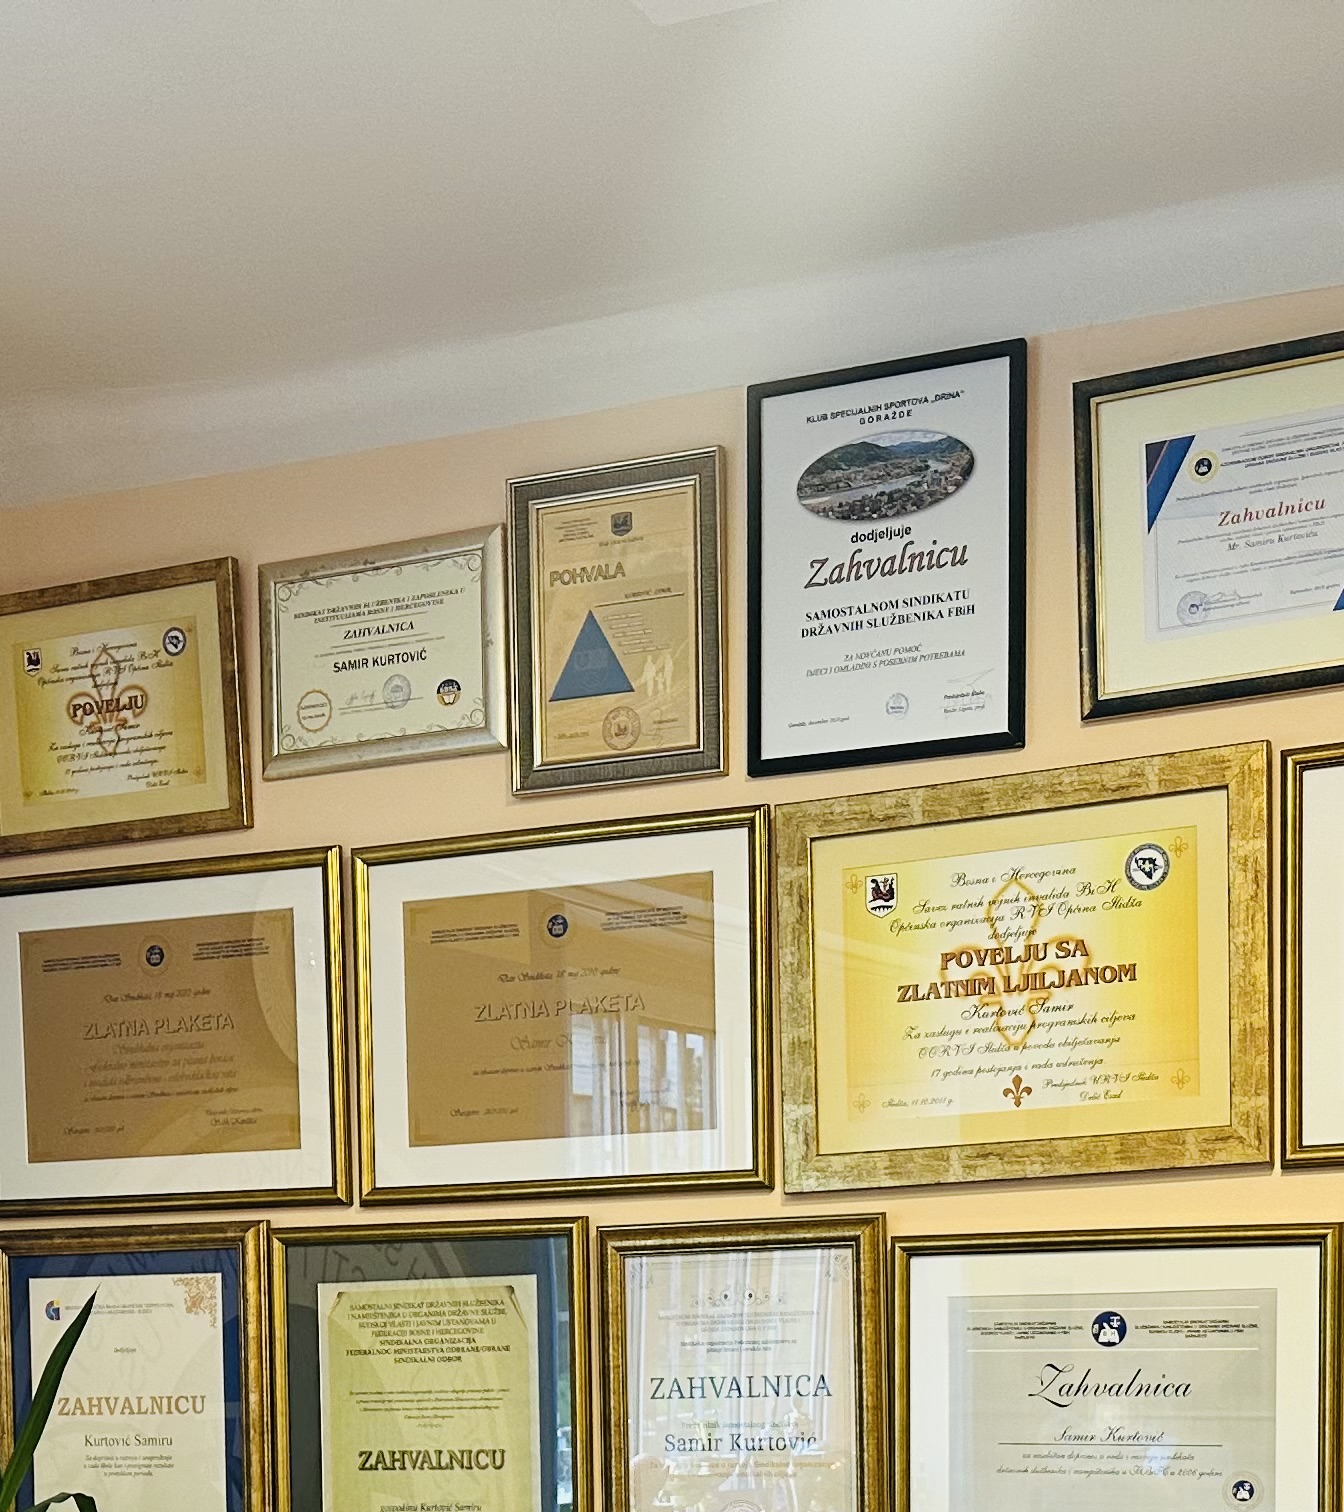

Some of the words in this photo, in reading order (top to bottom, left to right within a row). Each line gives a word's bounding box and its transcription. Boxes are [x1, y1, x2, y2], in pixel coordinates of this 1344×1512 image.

[807, 410, 828, 424] KLUB
[1218, 496, 1326, 528] Zahvalnicu
[851, 525, 912, 544] dodjeljuje
[549, 562, 626, 587] POHVALA
[803, 539, 969, 589] Zahvalnicu
[805, 598, 899, 622] SAMOSTALNOM
[902, 588, 971, 612] SINDIKATU
[343, 621, 415, 640] ZAHVALNICA
[801, 619, 864, 639] DRŽAVNIH
[866, 609, 944, 629] SLUŽBENIKA
[333, 658, 369, 673] SAMIR
[372, 647, 427, 667] KURTOVIĆ
[72, 695, 145, 718] POVELJU
[940, 941, 1048, 971] POVELJU
[1055, 937, 1089, 960] SA
[897, 975, 996, 1004] ZLATNIM
[1003, 961, 1137, 994] LJILJANOM
[473, 1000, 550, 1023] ZLATNA
[554, 992, 646, 1017] PLAKETA
[83, 1018, 150, 1041] ZLATNA
[154, 1012, 235, 1037] PLAKETA
[649, 1374, 832, 1401] ZAHVALNICA
[1027, 1362, 1193, 1408] Zahvalnica
[57, 1395, 207, 1417] ZAHVALNICU
[84, 1433, 132, 1447] Kurtović
[134, 1433, 174, 1447] Samiru
[664, 1433, 723, 1452] Samir
[358, 1449, 506, 1471] ZAHVALNICU
